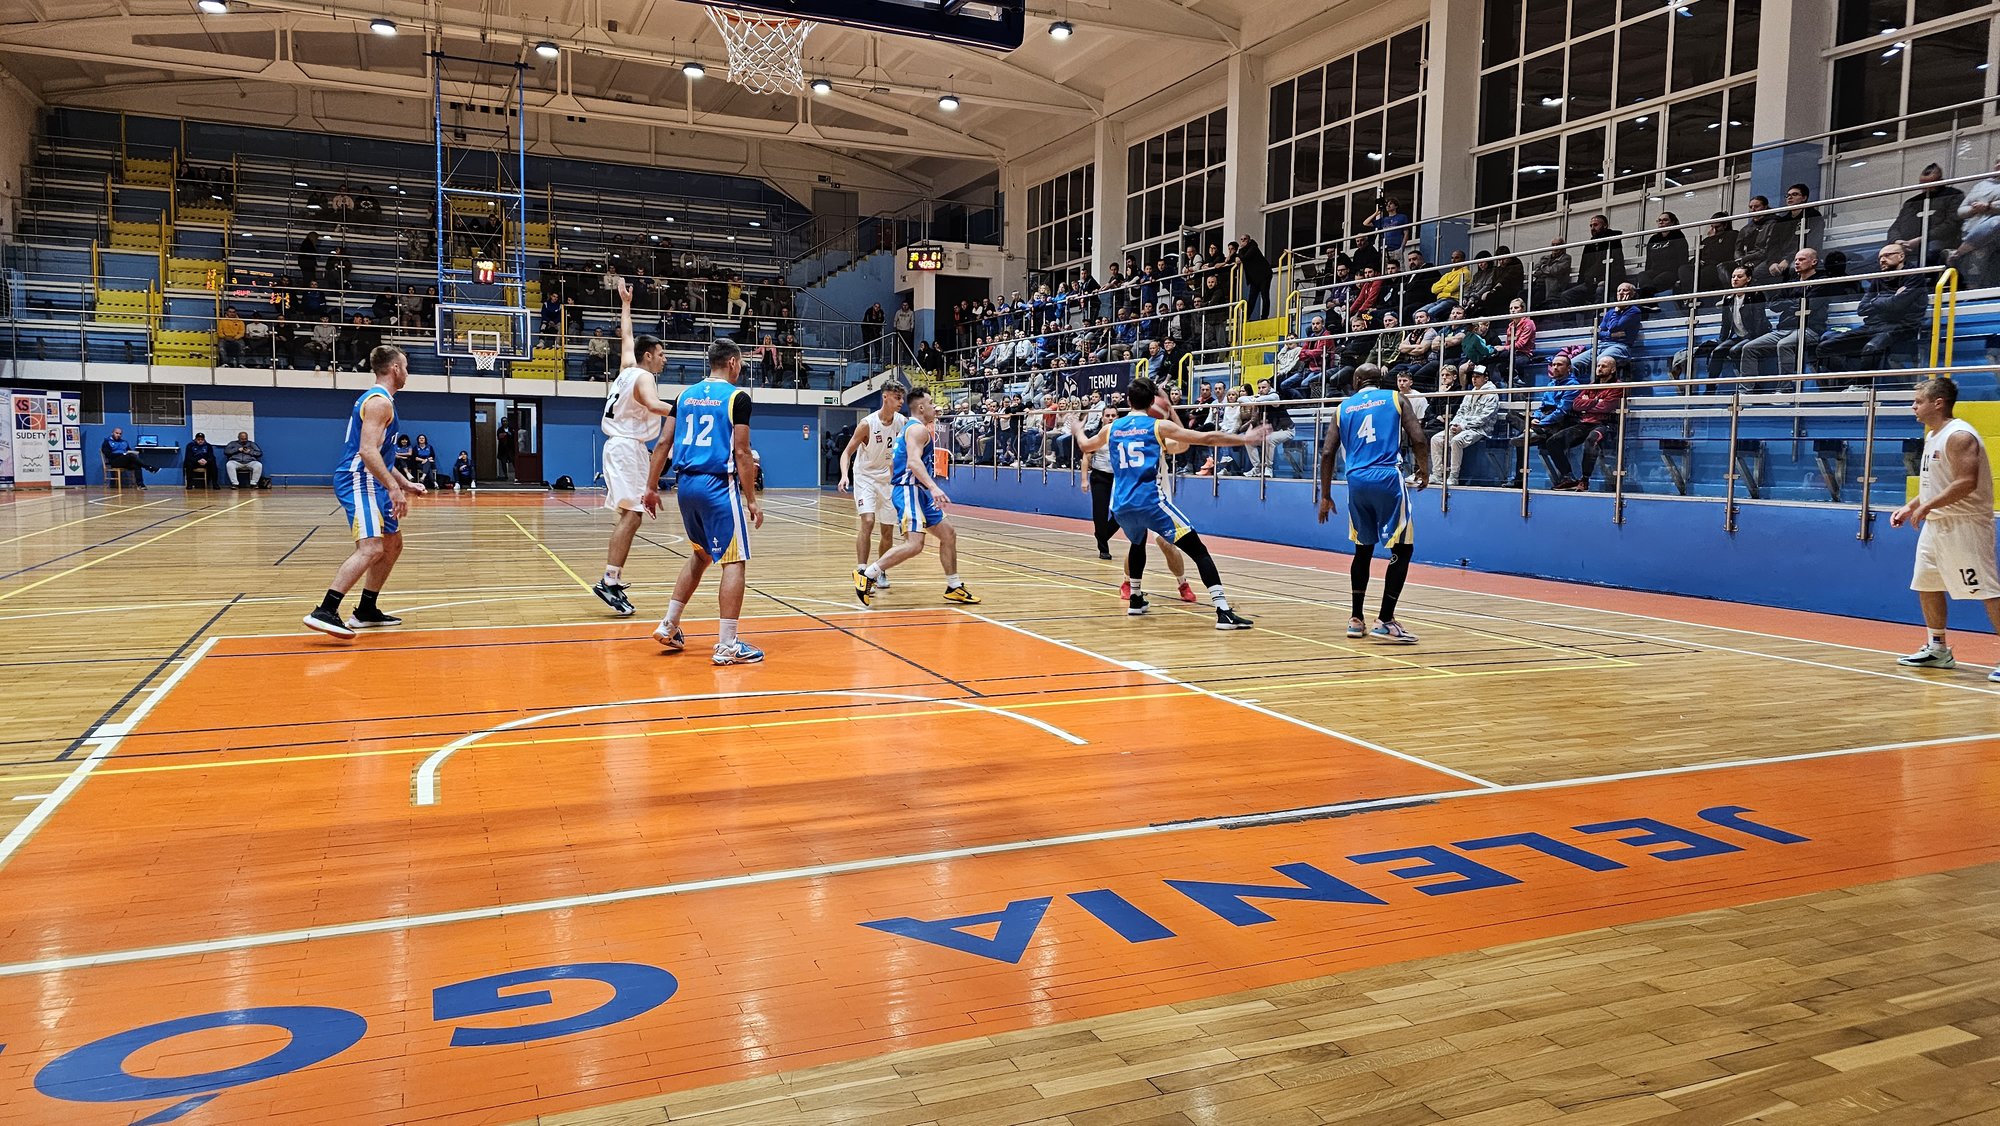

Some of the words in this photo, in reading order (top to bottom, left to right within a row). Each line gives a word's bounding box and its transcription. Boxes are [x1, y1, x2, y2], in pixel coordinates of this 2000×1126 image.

[1088, 373, 1118, 390] TERMY
[16, 432, 47, 440] SUDETY
[682, 413, 715, 447] 12
[1357, 414, 1377, 444] 4
[887, 436, 893, 449] 2
[1117, 441, 1145, 469] 15
[1959, 568, 1979, 586] 12
[857, 805, 1812, 964] JELENIA
